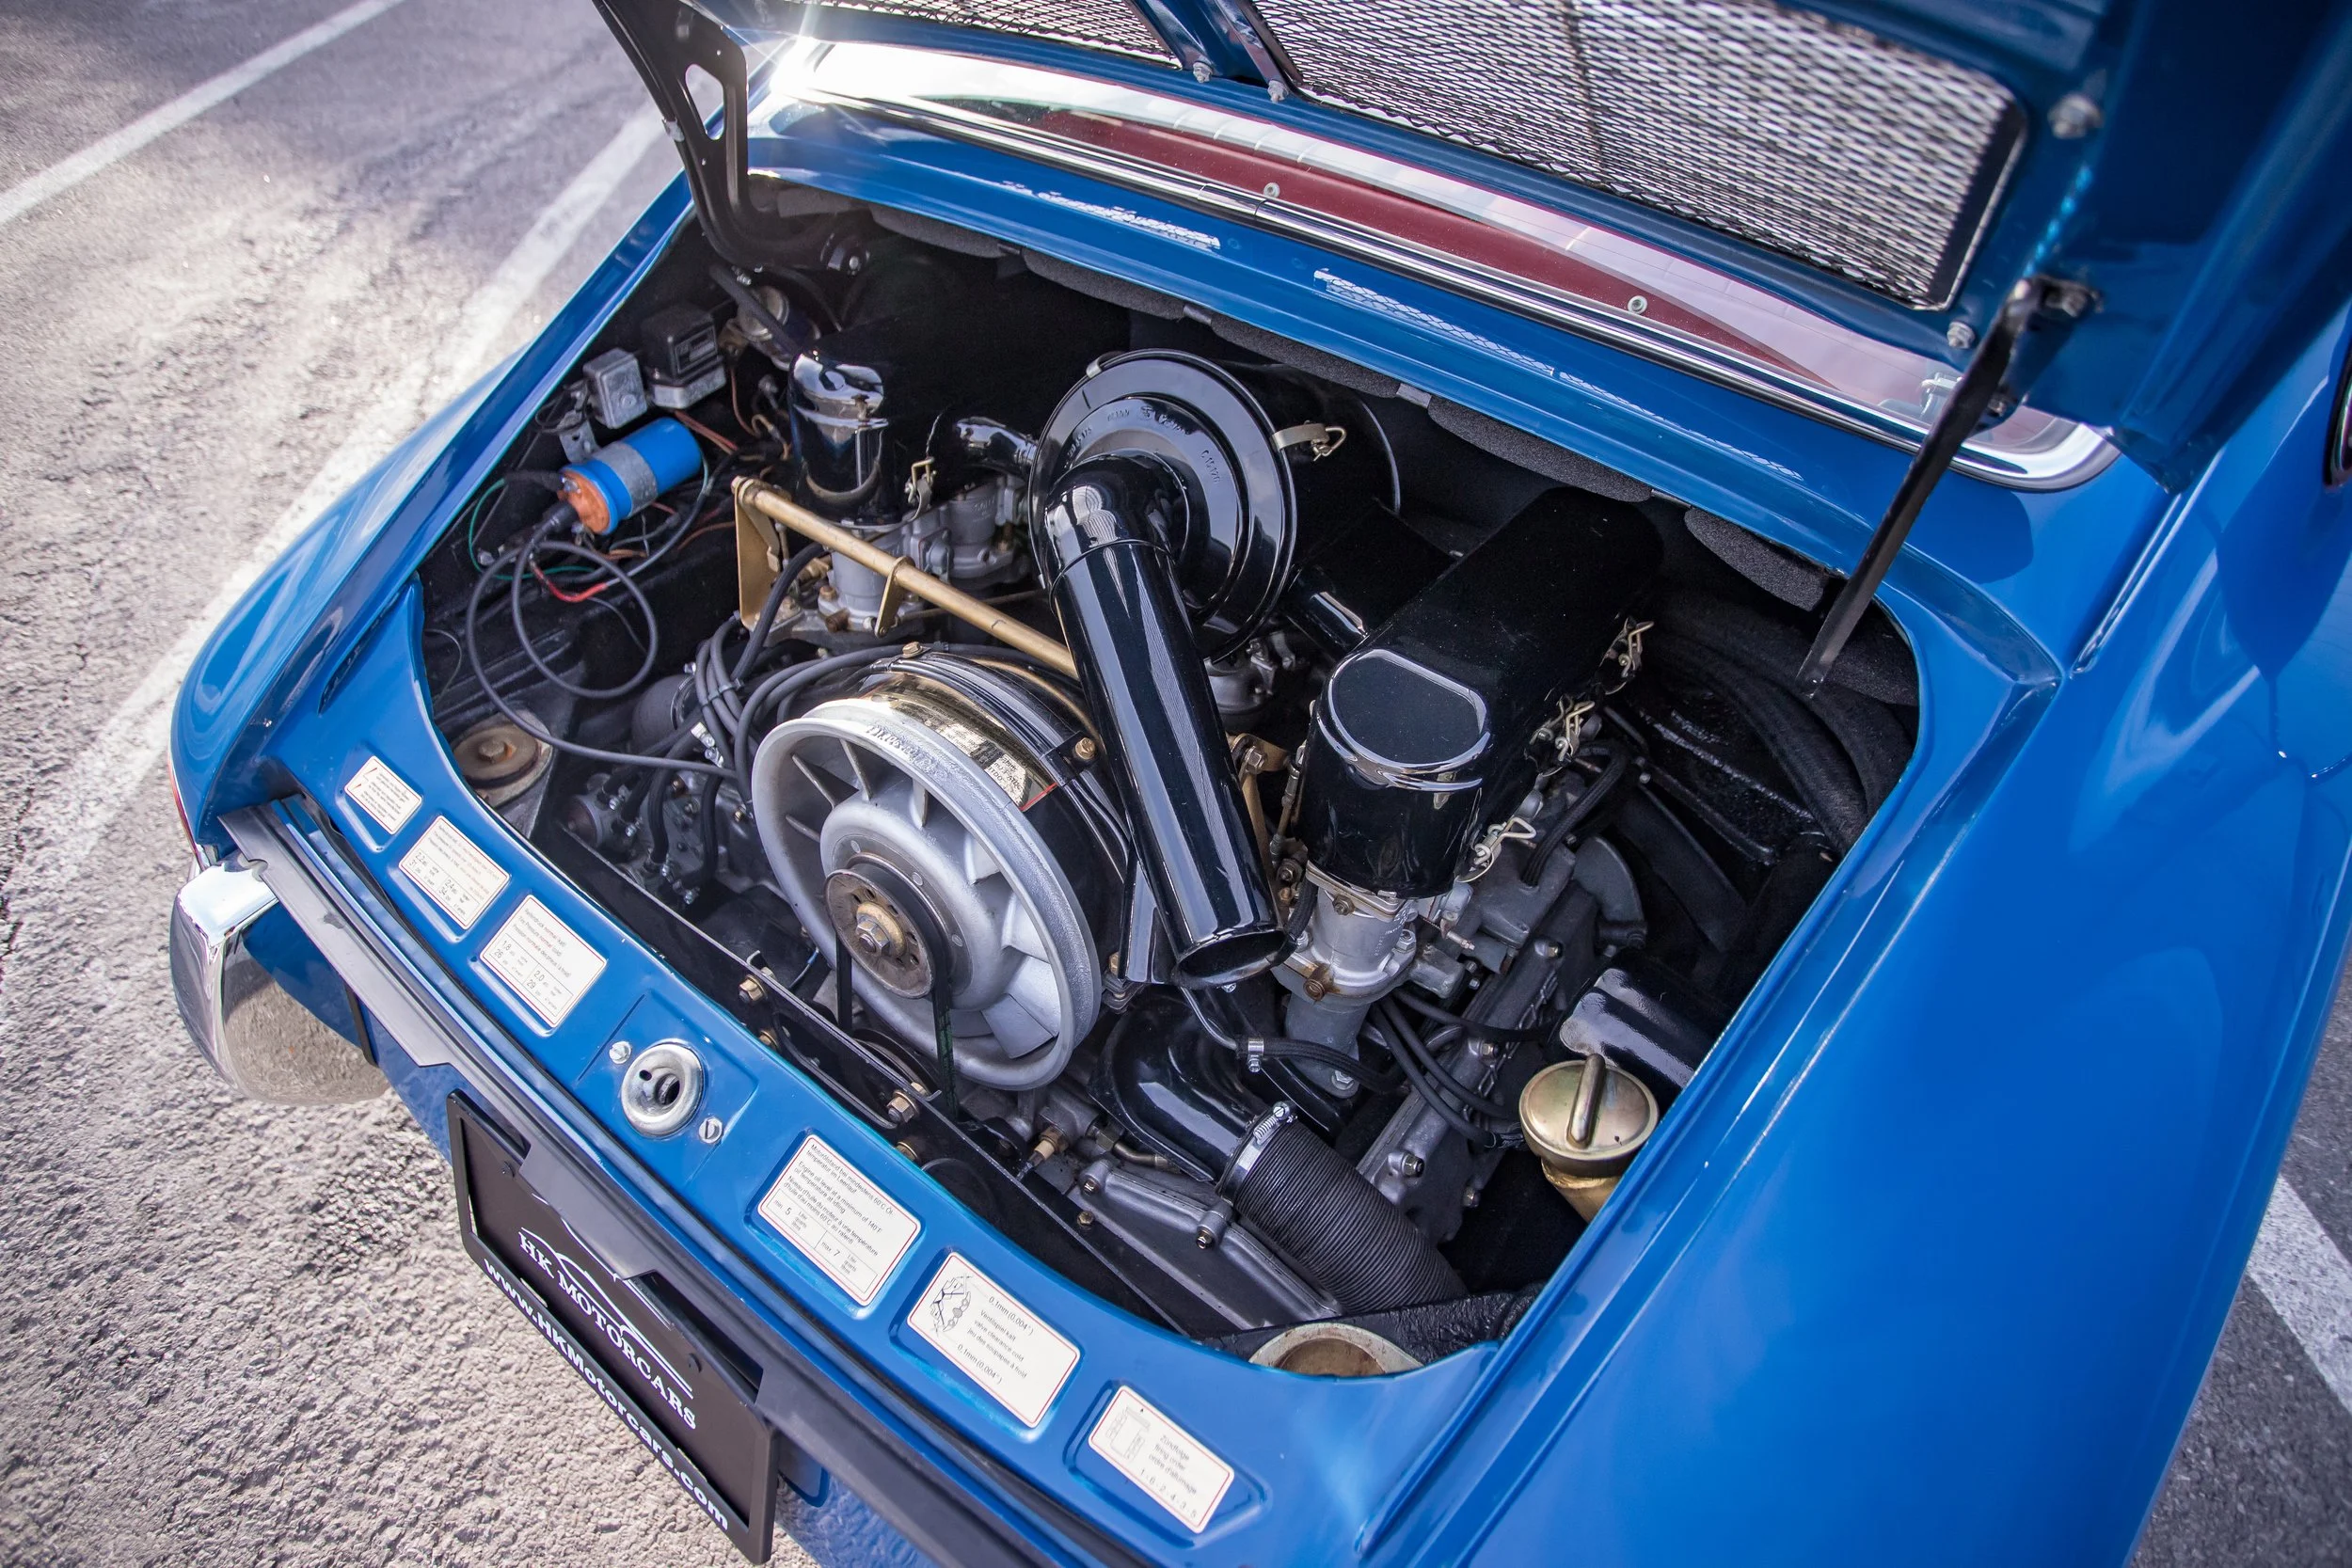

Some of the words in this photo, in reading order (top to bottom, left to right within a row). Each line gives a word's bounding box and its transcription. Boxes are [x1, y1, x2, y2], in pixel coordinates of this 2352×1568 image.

[494, 948, 503, 958] 26
[526, 978, 535, 989] 29
[805, 1149, 831, 1172] temperatur
[836, 1175, 857, 1194] Leerlauf
[838, 1167, 848, 1178] bei
[847, 1176, 873, 1199] mindestens
[787, 1175, 803, 1192] Niveau
[821, 1207, 838, 1222] moteur
[841, 1224, 850, 1233] une
[798, 1161, 814, 1177] Engine
[819, 1180, 832, 1192] level
[840, 1197, 862, 1217] minimum
[800, 1171, 827, 1197] temperature
[832, 1199, 846, 1214] idling
[785, 1207, 791, 1215] 5
[806, 1202, 819, 1215] moins
[518, 1231, 555, 1279] HK
[558, 1271, 697, 1430] MOTORCARS
[974, 1320, 987, 1332] valve
[987, 1331, 1011, 1352] clearance
[1011, 1351, 1024, 1362] cold
[980, 1309, 1007, 1333] Ventilspiel
[1005, 1330, 1015, 1341] kalt
[966, 1327, 977, 1338] jeu
[976, 1336, 986, 1344] des
[985, 1343, 1009, 1365] soupapes
[1014, 1366, 1027, 1378] froid
[485, 1259, 728, 1531] www.HKMotorcars.com
[1148, 1453, 1165, 1468] ordre
[1153, 1443, 1168, 1460] firing
[1168, 1457, 1185, 1470] order
[1159, 1434, 1189, 1461] Zündfolge
